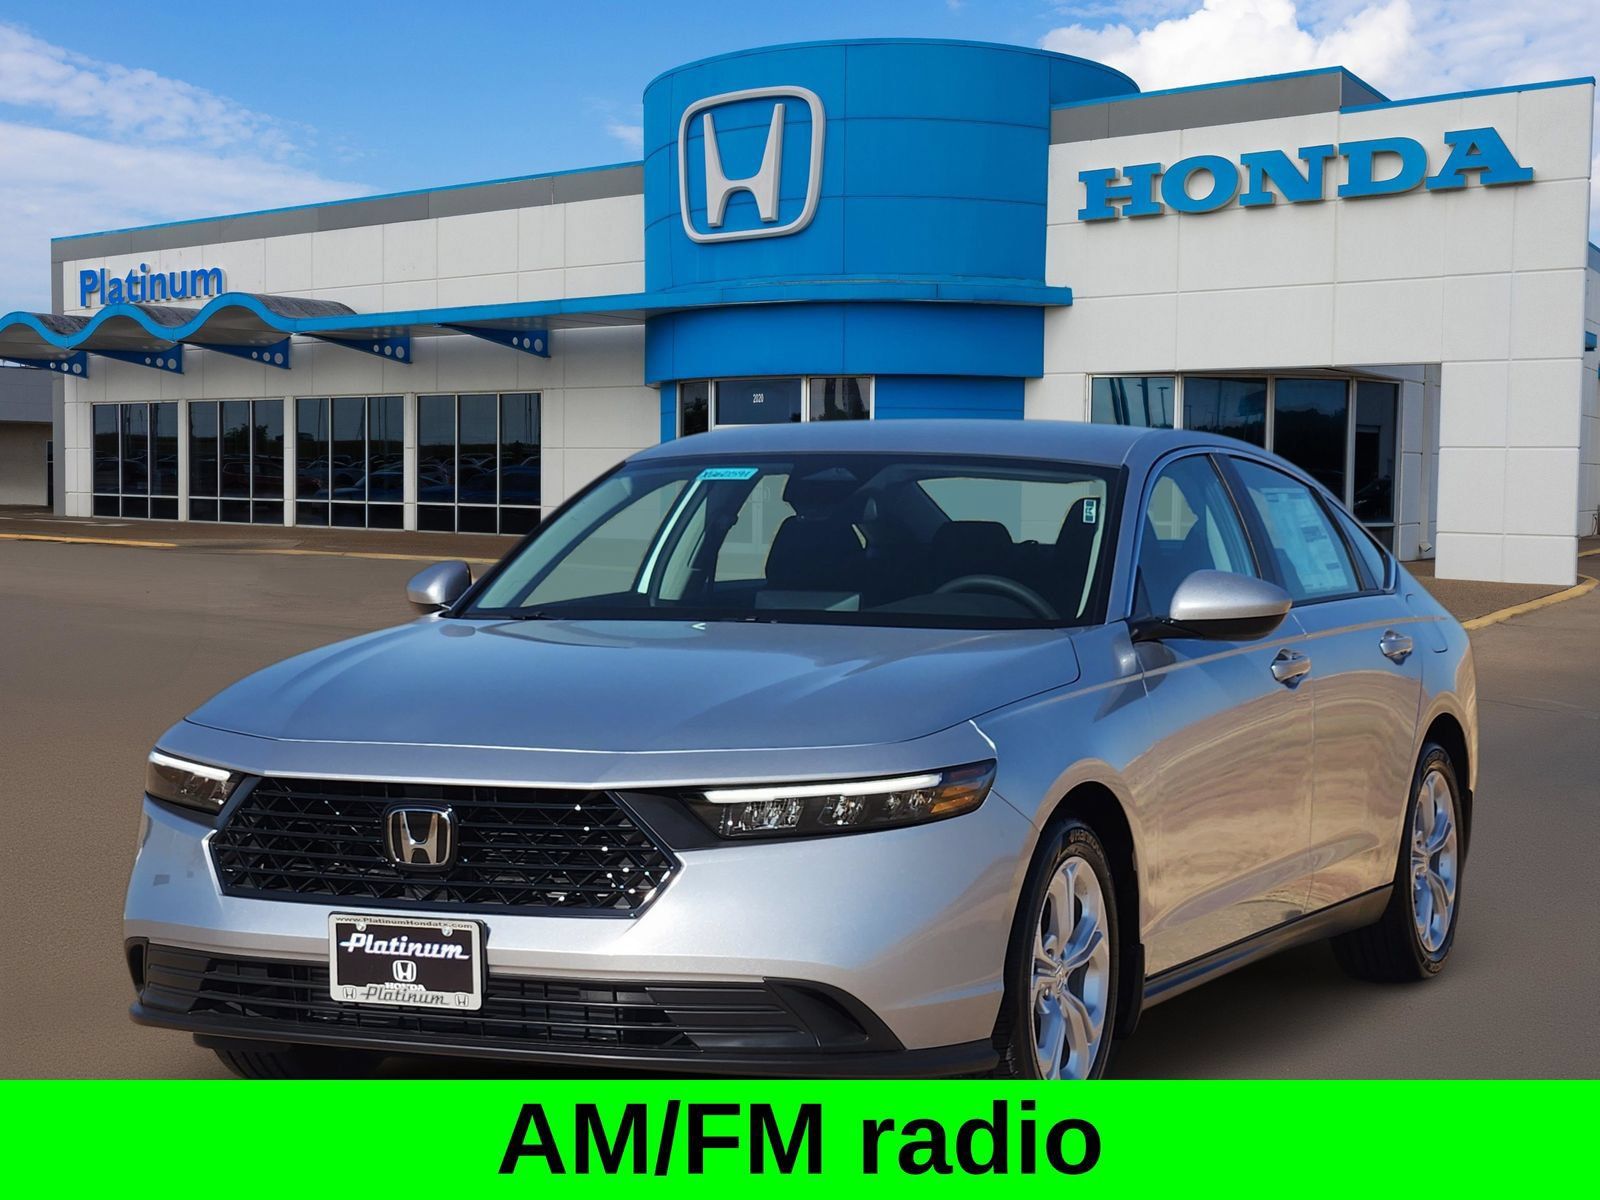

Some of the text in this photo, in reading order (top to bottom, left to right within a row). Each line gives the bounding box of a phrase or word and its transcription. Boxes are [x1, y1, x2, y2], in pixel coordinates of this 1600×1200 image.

[1078, 127, 1533, 221] HONDA
[80, 263, 223, 307] Platinum
[339, 933, 470, 959] Platinum
[361, 986, 449, 1005] Platinum
